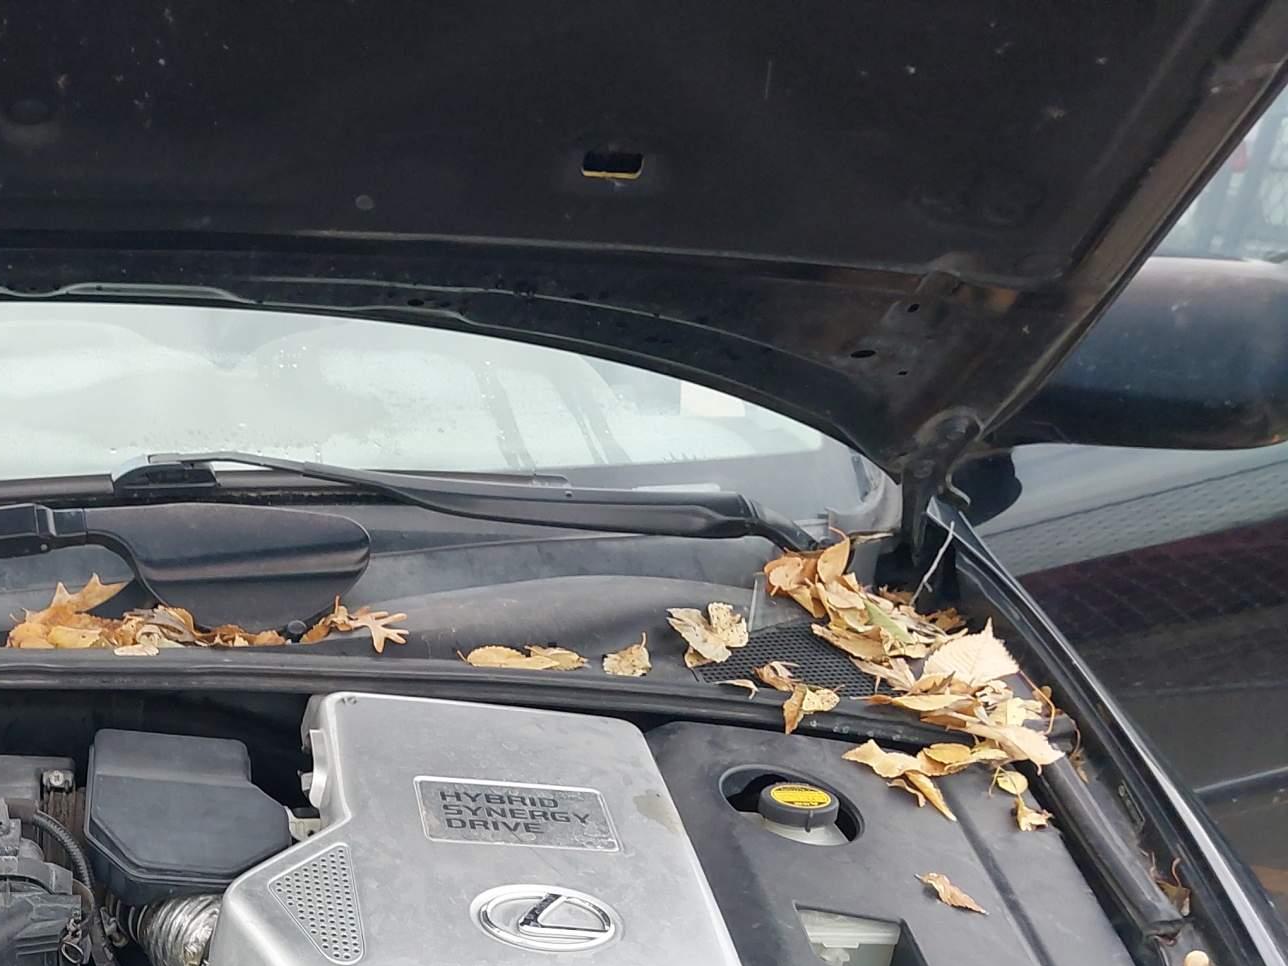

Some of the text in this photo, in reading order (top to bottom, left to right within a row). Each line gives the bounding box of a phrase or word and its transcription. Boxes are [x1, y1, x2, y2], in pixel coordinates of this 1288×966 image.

[439, 791, 559, 809] HYBRID
[442, 804, 590, 825] SYNERGY
[445, 818, 545, 834] DRIVE
